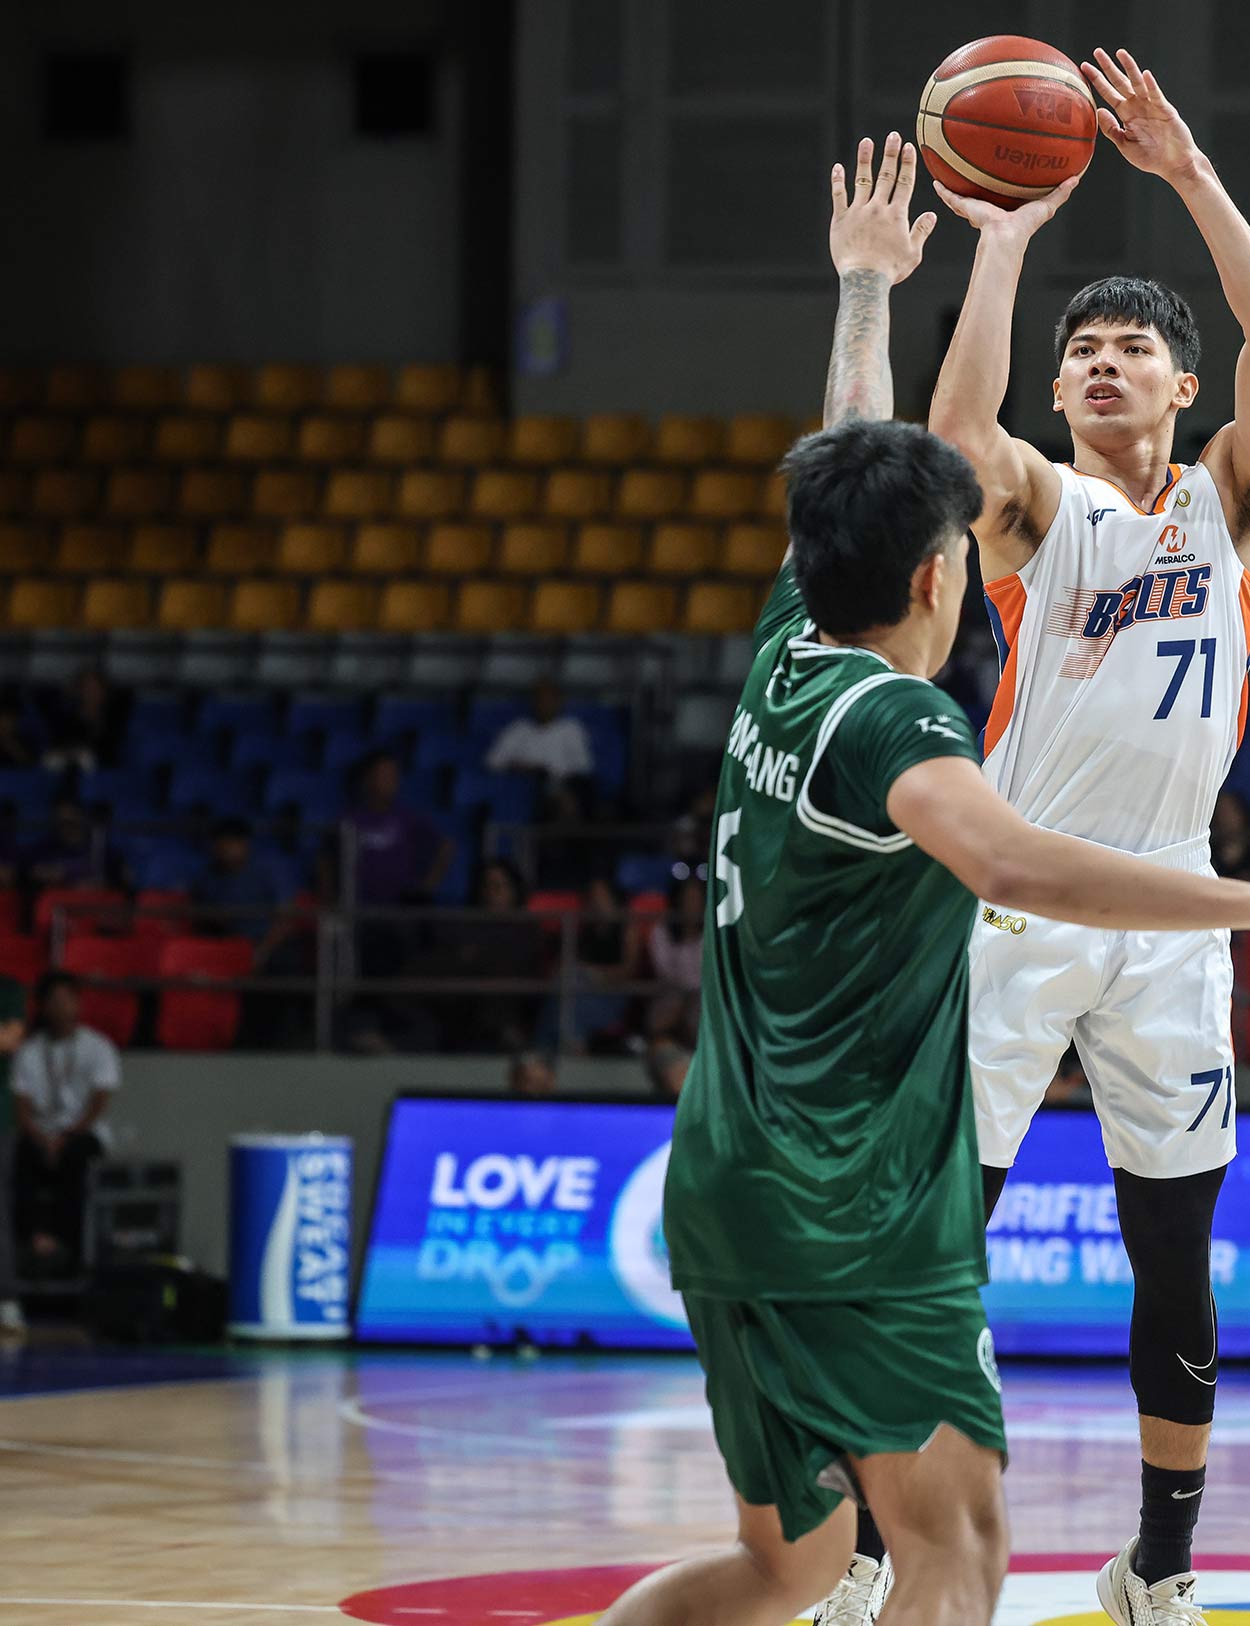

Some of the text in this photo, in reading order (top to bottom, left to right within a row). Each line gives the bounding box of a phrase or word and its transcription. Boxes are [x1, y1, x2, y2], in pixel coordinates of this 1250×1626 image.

[994, 144, 1070, 170] molten
[1155, 553, 1196, 565] MERALCO
[1081, 563, 1213, 641] BOLTS
[1152, 637, 1217, 721] 71
[1185, 1064, 1232, 1133] 71
[430, 1151, 600, 1211] LOVE
[296, 1153, 326, 1304] SWEAT
[417, 1238, 581, 1308] DROP
